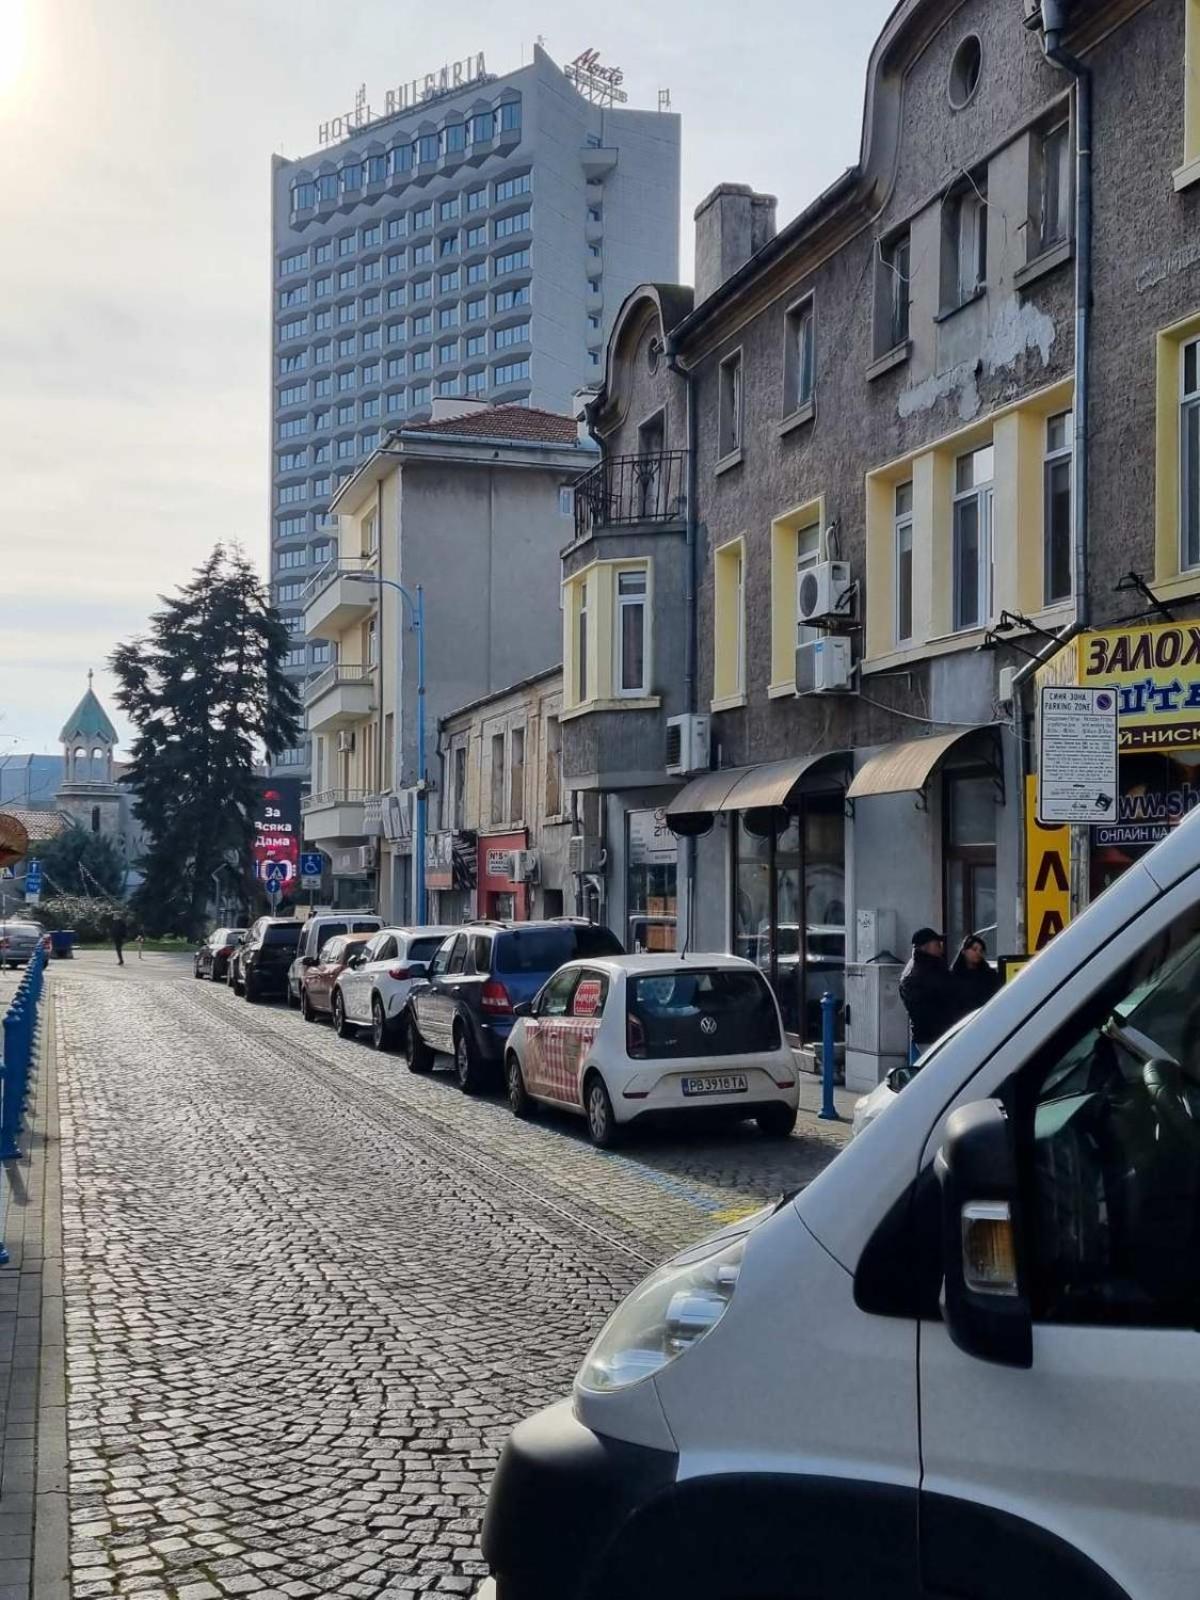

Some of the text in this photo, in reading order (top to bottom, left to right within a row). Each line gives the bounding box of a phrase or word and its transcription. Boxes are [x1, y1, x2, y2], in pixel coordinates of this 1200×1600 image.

[1044, 702, 1091, 711] PARKING ZONE
[264, 806, 281, 817] За
[1100, 826, 1149, 842] ОНЛАЙН
[255, 835, 290, 847] Дама
